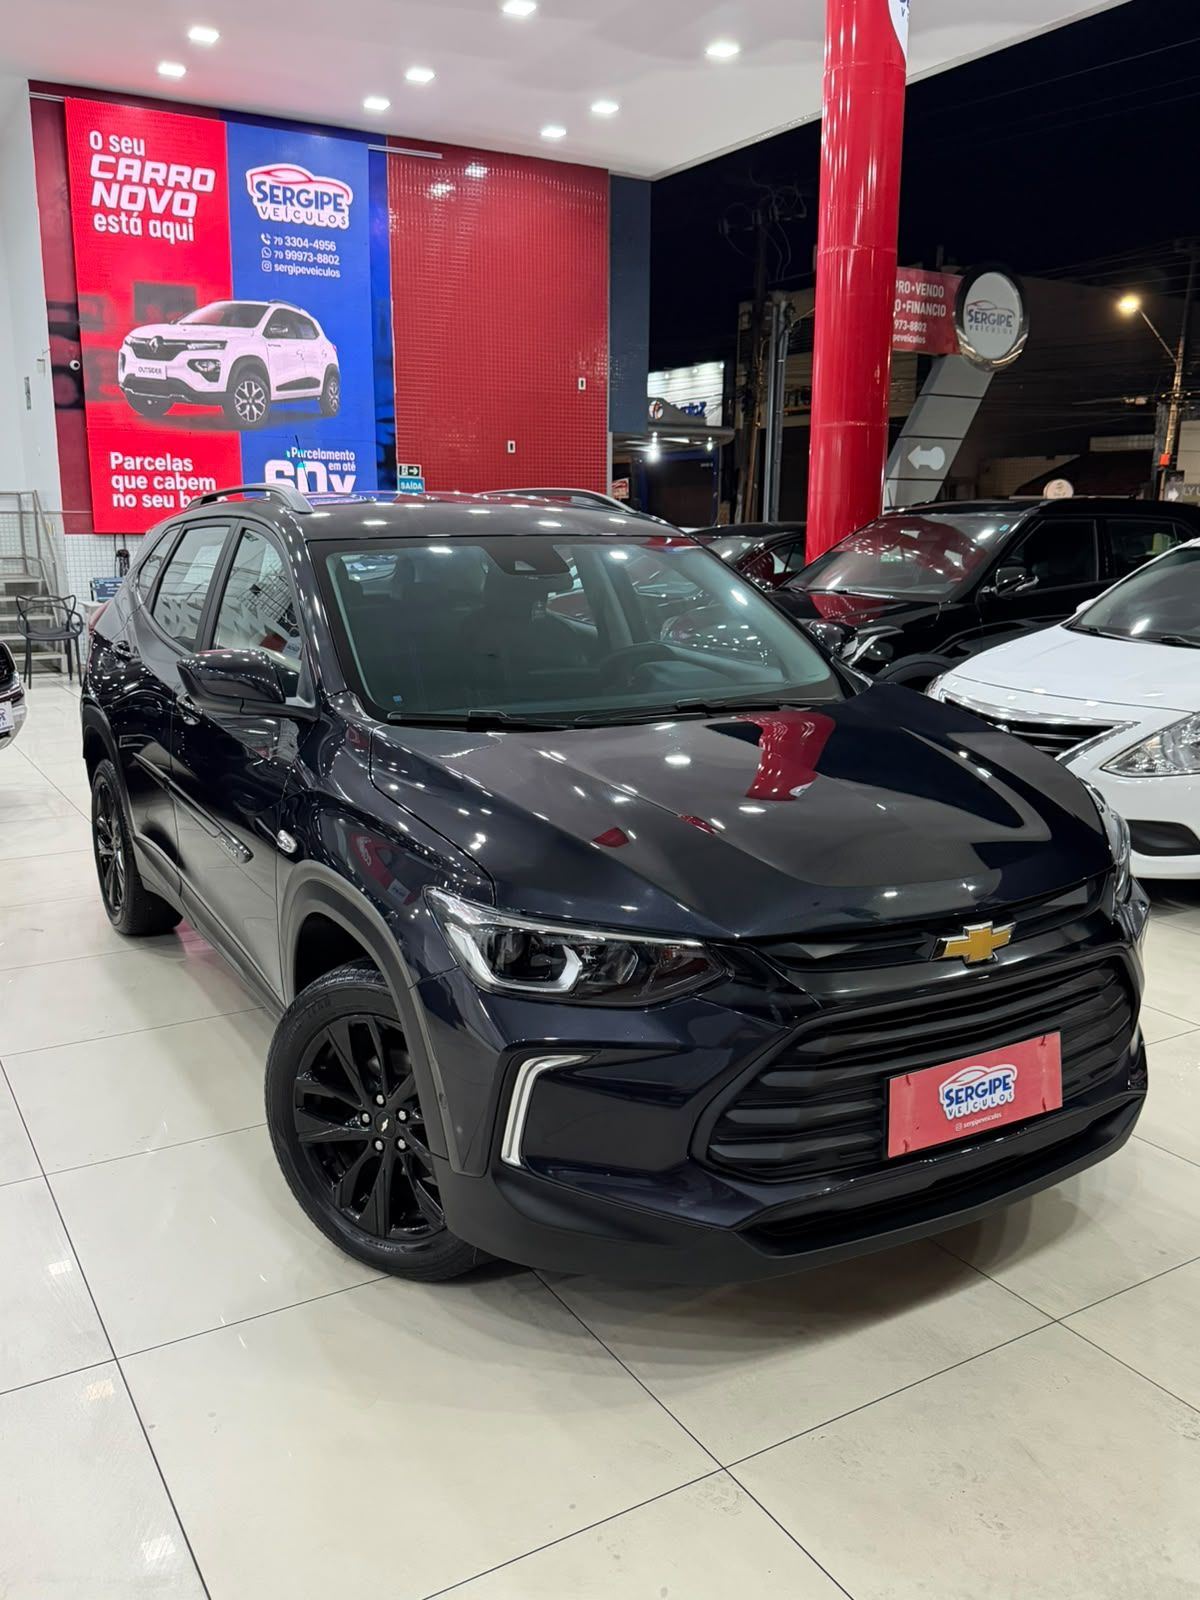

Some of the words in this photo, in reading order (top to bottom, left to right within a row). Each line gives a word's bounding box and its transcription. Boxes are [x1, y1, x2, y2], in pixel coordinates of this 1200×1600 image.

[108, 135, 145, 156] seu
[90, 153, 216, 192] CARRO
[91, 180, 198, 217] NOVO
[255, 180, 345, 213] SERGIPE
[260, 205, 346, 226] VEÍCULOS
[93, 211, 142, 236] está
[148, 217, 194, 245] aqui
[284, 235, 337, 252] 3304-4956
[285, 249, 341, 265] 99973-8802
[273, 262, 341, 278] sergipeveiculos
[967, 309, 1013, 328] SERGIPE
[110, 451, 193, 472] Parcelas
[291, 446, 355, 461] Parcelamento
[328, 463, 341, 471] em
[342, 461, 356, 472] até
[111, 474, 148, 492] que
[153, 471, 217, 491] cabem
[400, 479, 423, 491] SAÍDA
[112, 493, 137, 508] no
[142, 494, 175, 508] seu
[945, 1074, 1012, 1108] SERGIPE
